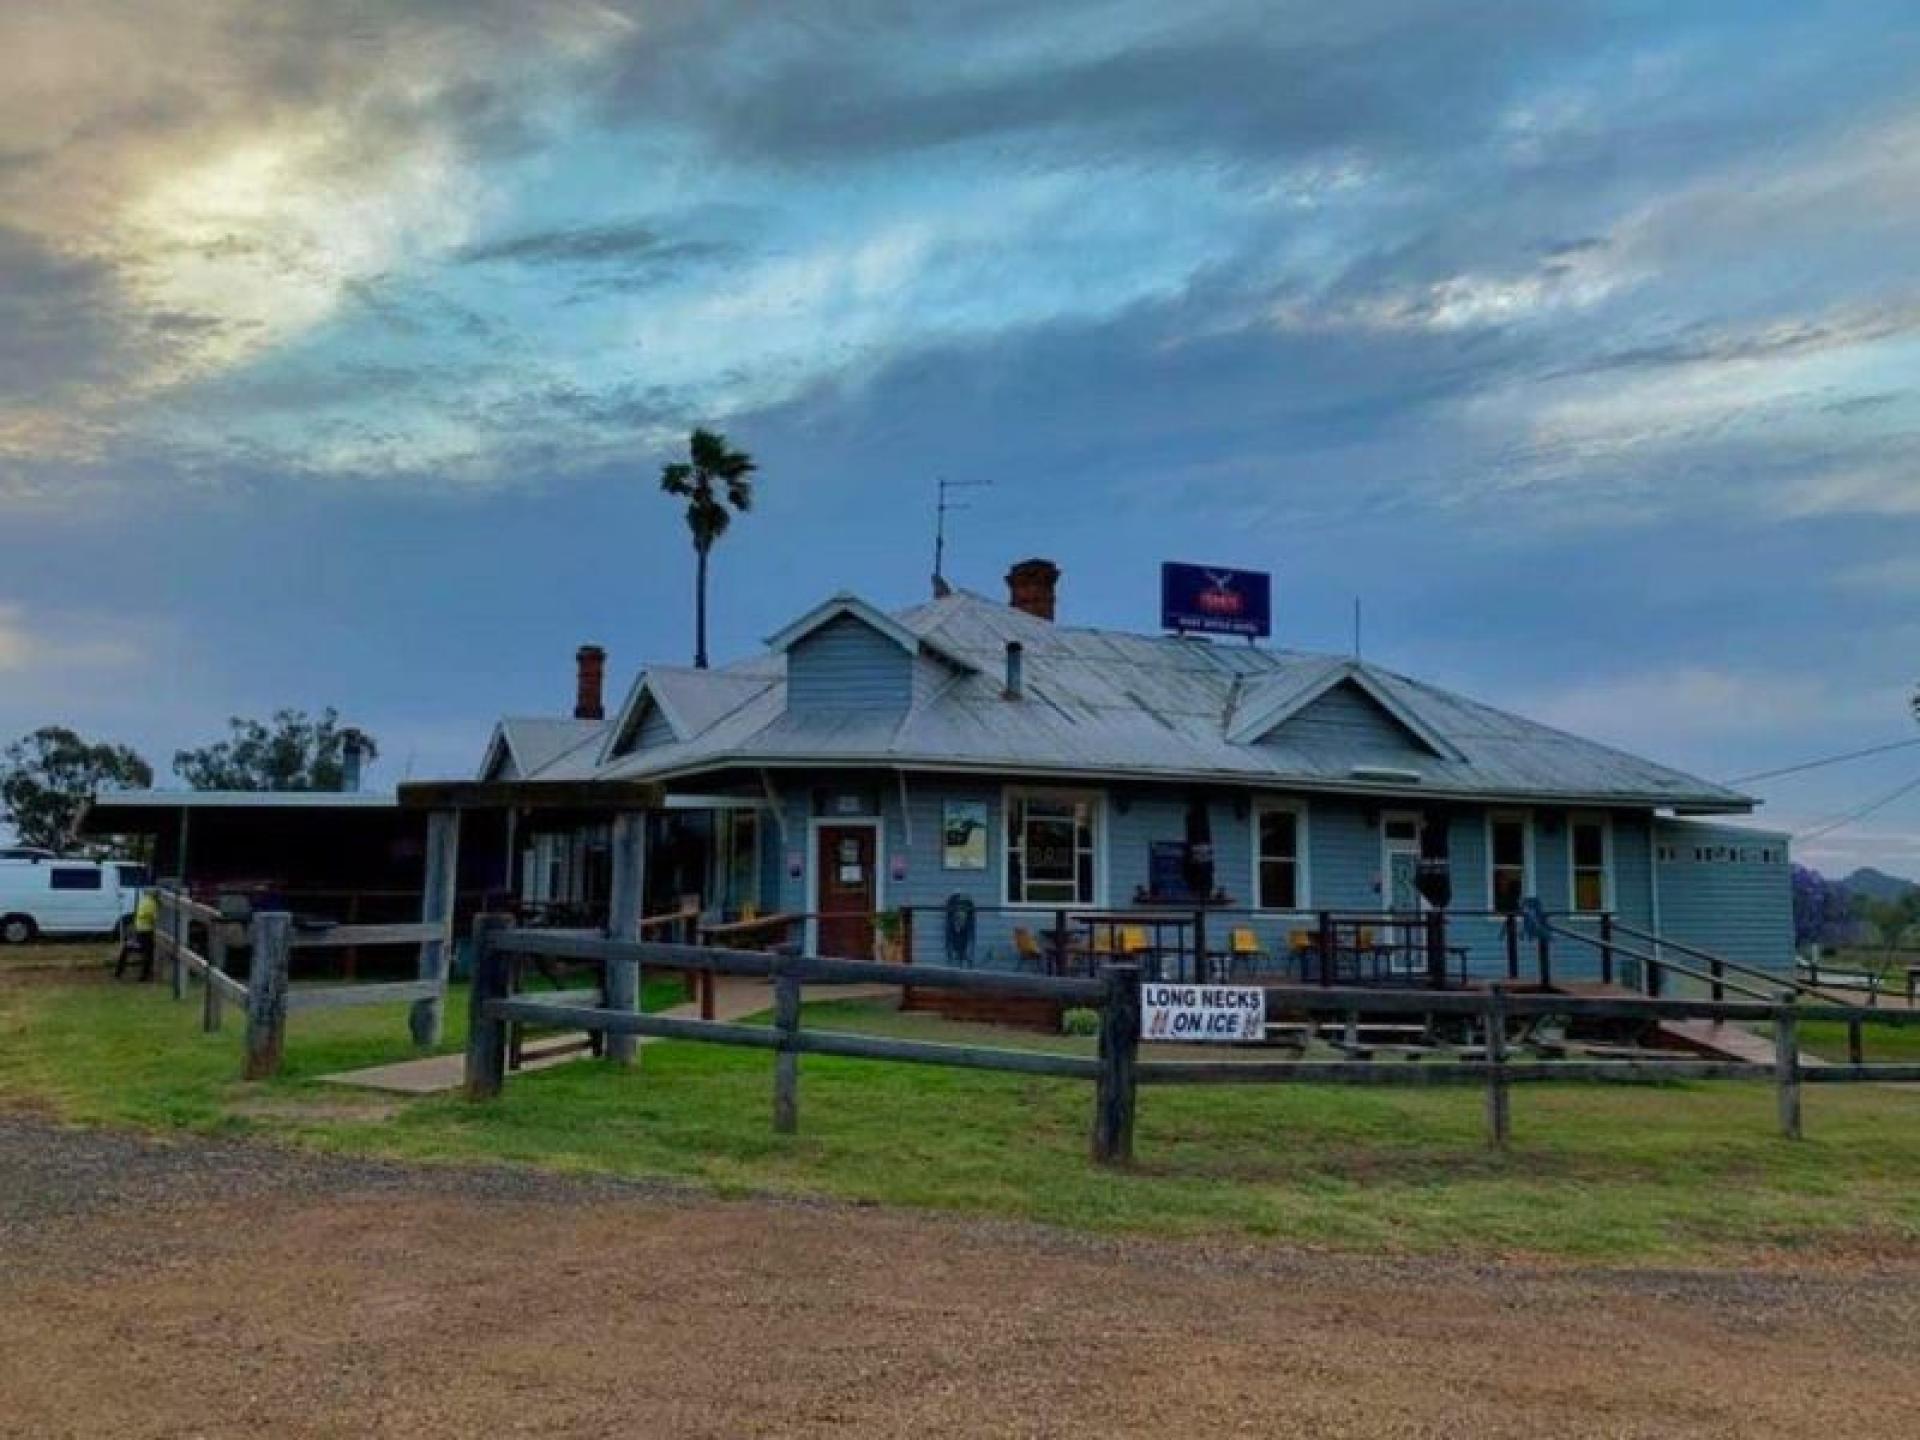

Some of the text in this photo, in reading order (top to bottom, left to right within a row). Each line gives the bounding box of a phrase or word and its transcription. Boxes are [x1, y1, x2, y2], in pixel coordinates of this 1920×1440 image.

[1146, 988, 1260, 1009] LONG NECKS
[1174, 1012, 1240, 1033] ON ICE
